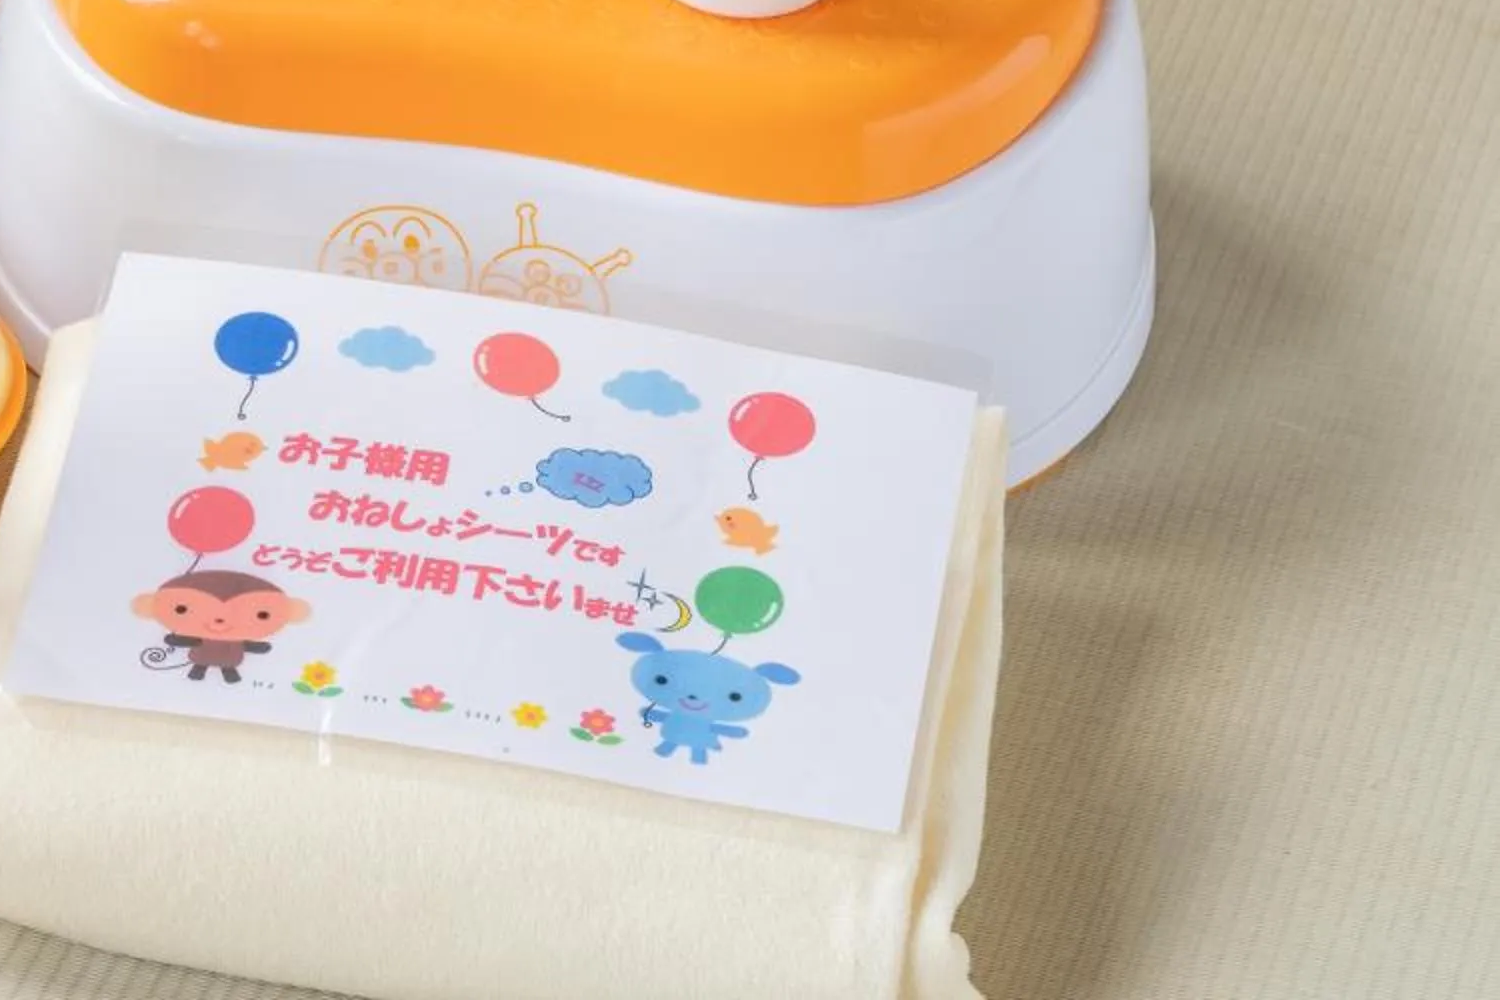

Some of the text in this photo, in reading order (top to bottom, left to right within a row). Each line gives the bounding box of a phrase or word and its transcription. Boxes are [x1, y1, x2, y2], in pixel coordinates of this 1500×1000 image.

[278, 432, 451, 487] お子様用
[308, 490, 627, 568] おねしょシーツです
